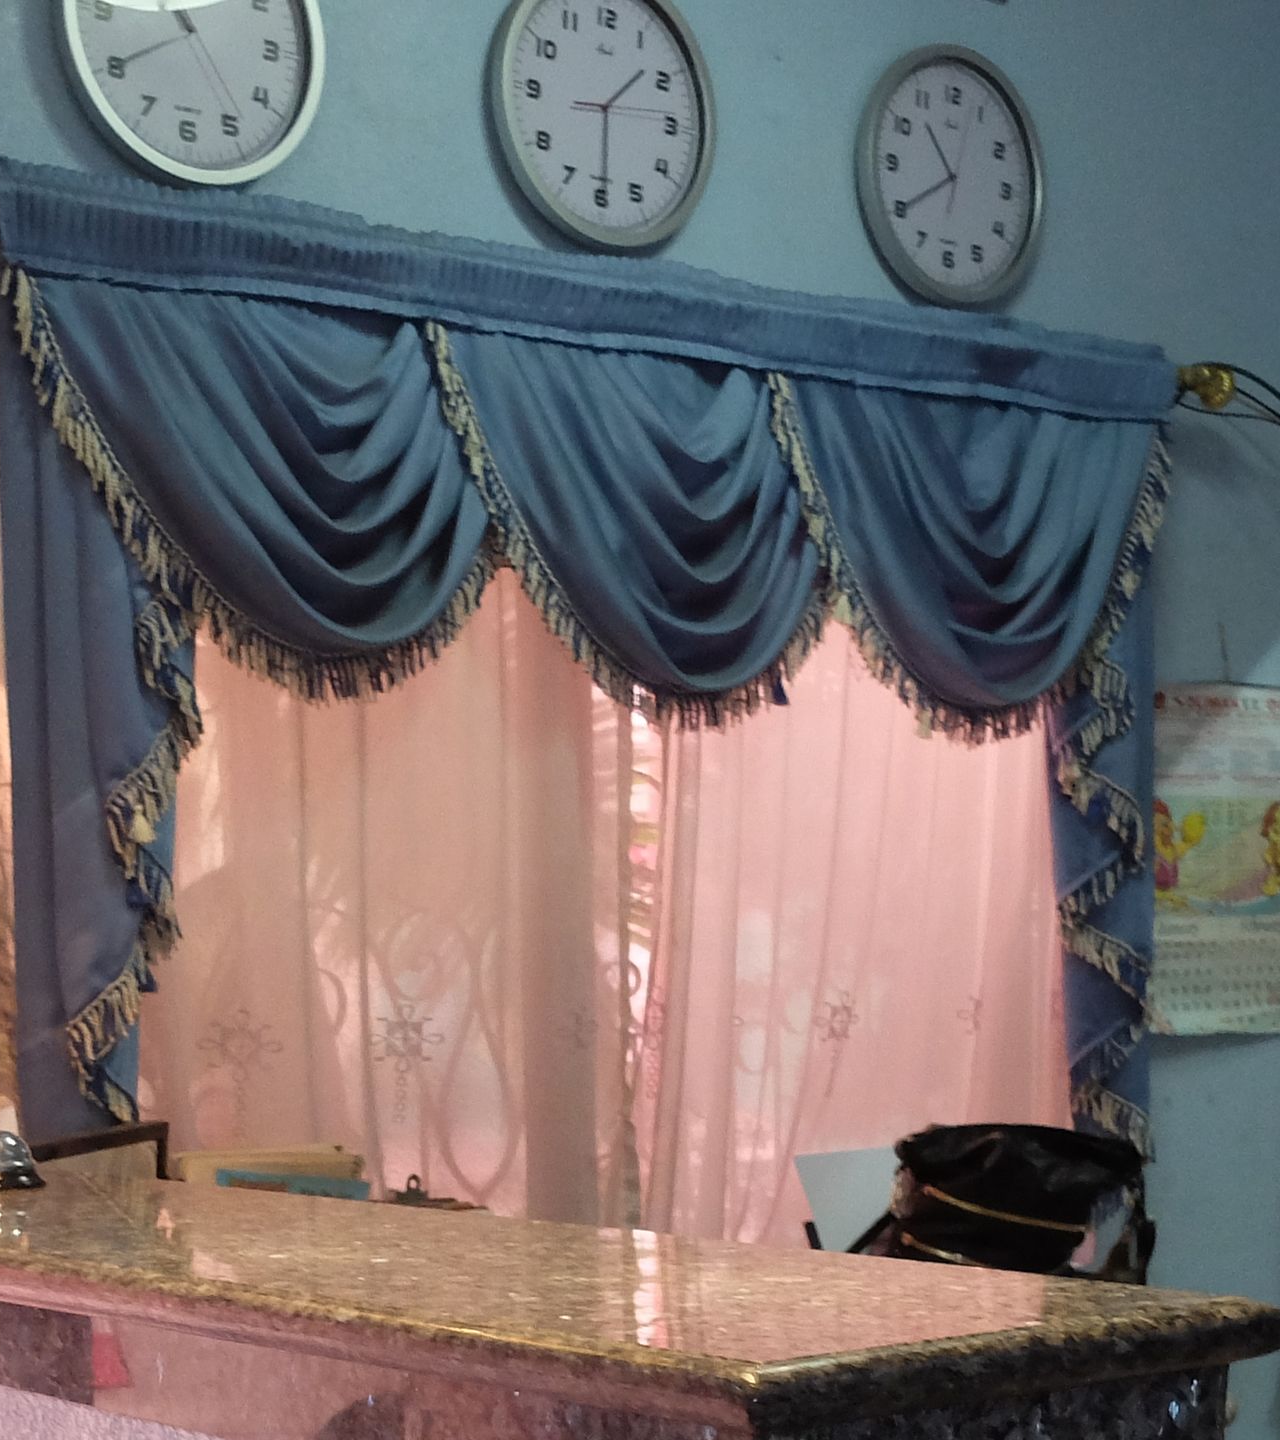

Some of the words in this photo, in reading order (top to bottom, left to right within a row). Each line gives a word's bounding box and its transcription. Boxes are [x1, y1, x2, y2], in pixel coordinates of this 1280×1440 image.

[597, 7, 618, 30] 12
[262, 39, 280, 62] 3
[536, 38, 557, 60] 10
[107, 55, 125, 79] 8
[526, 78, 541, 100] 9
[655, 69, 671, 92] 2
[140, 93, 157, 116] 7
[251, 86, 269, 110] 4
[945, 84, 962, 105] 12
[178, 120, 197, 143] 6
[221, 113, 240, 137] 5
[664, 115, 679, 136] 3
[536, 130, 552, 151] 8
[993, 140, 1006, 161] 2
[654, 158, 668, 178] 4
[886, 153, 900, 173] 9
[563, 165, 577, 185] 7
[628, 182, 644, 203] 5
[1000, 181, 1012, 201] 3
[916, 229, 928, 248] 7
[942, 250, 955, 270] 6
[970, 243, 984, 264] 5
